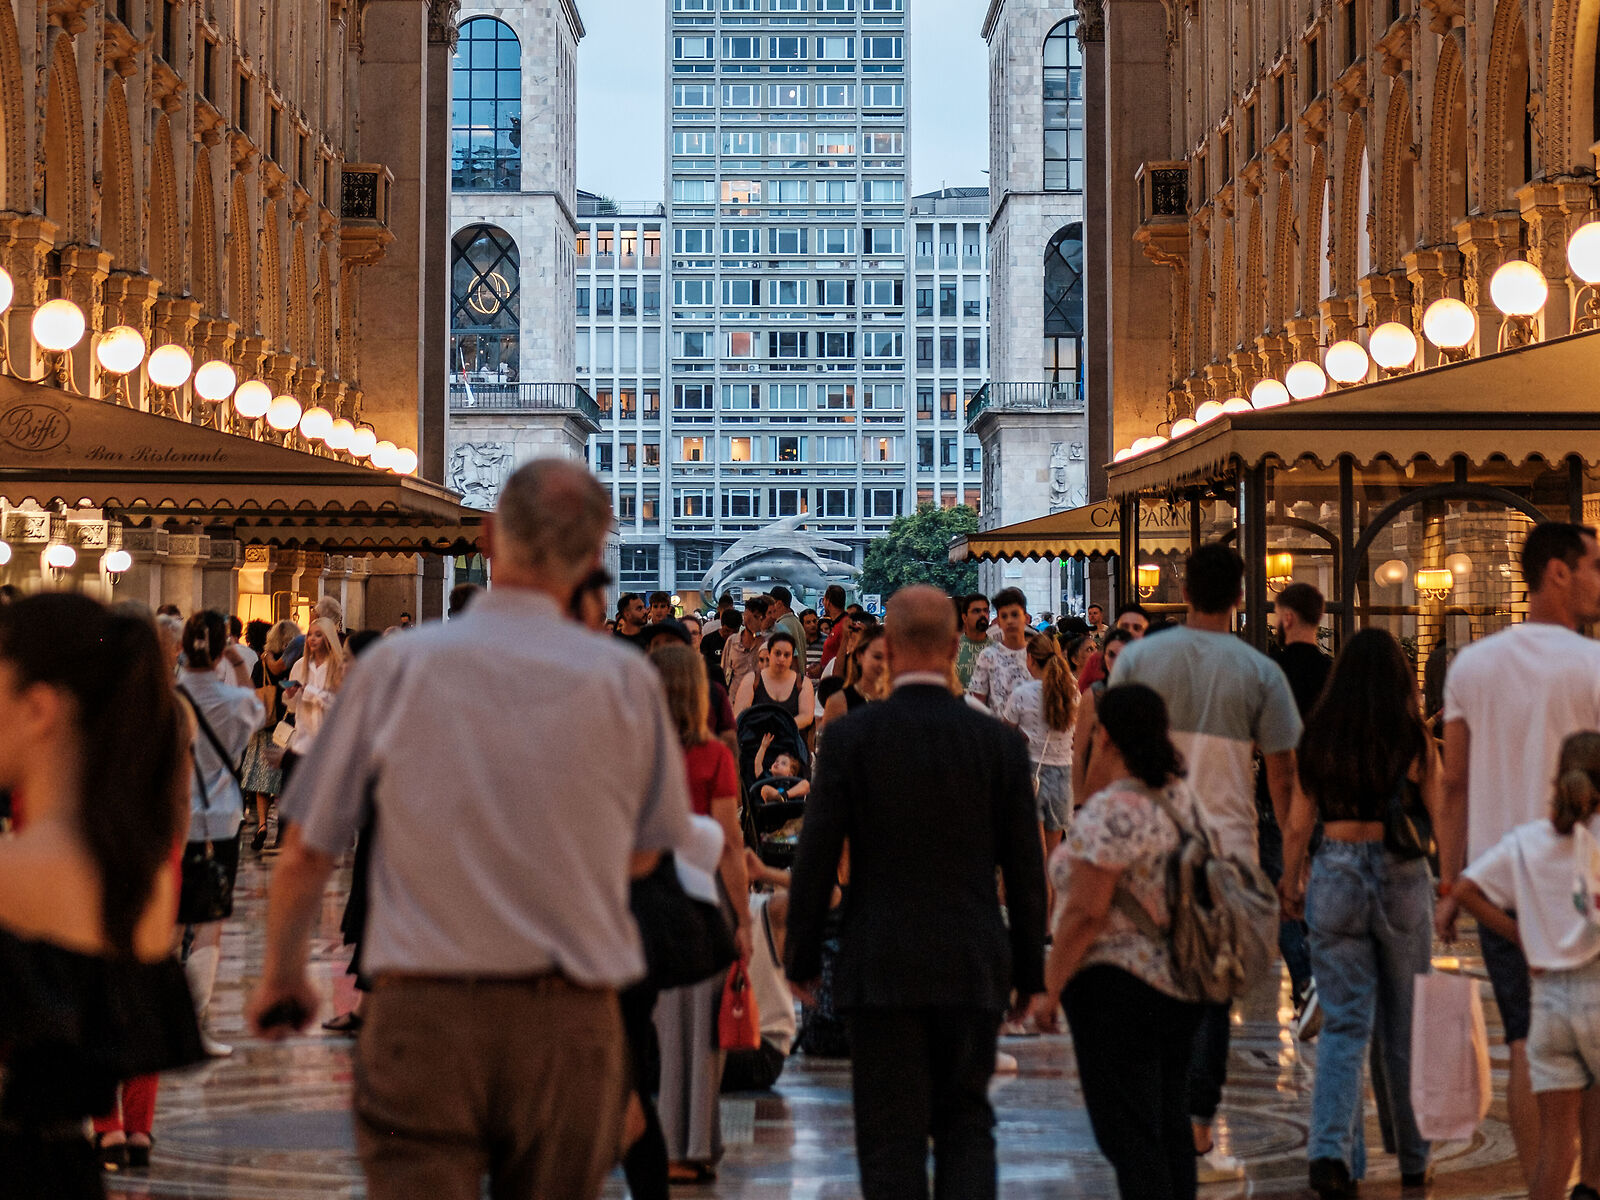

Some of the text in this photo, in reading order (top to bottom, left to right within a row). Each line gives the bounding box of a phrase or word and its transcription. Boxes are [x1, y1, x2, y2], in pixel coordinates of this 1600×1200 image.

[3, 407, 61, 449] Biffi
[84, 445, 230, 462] Bar Ristorante
[1091, 507, 1207, 527] CAPARINO
